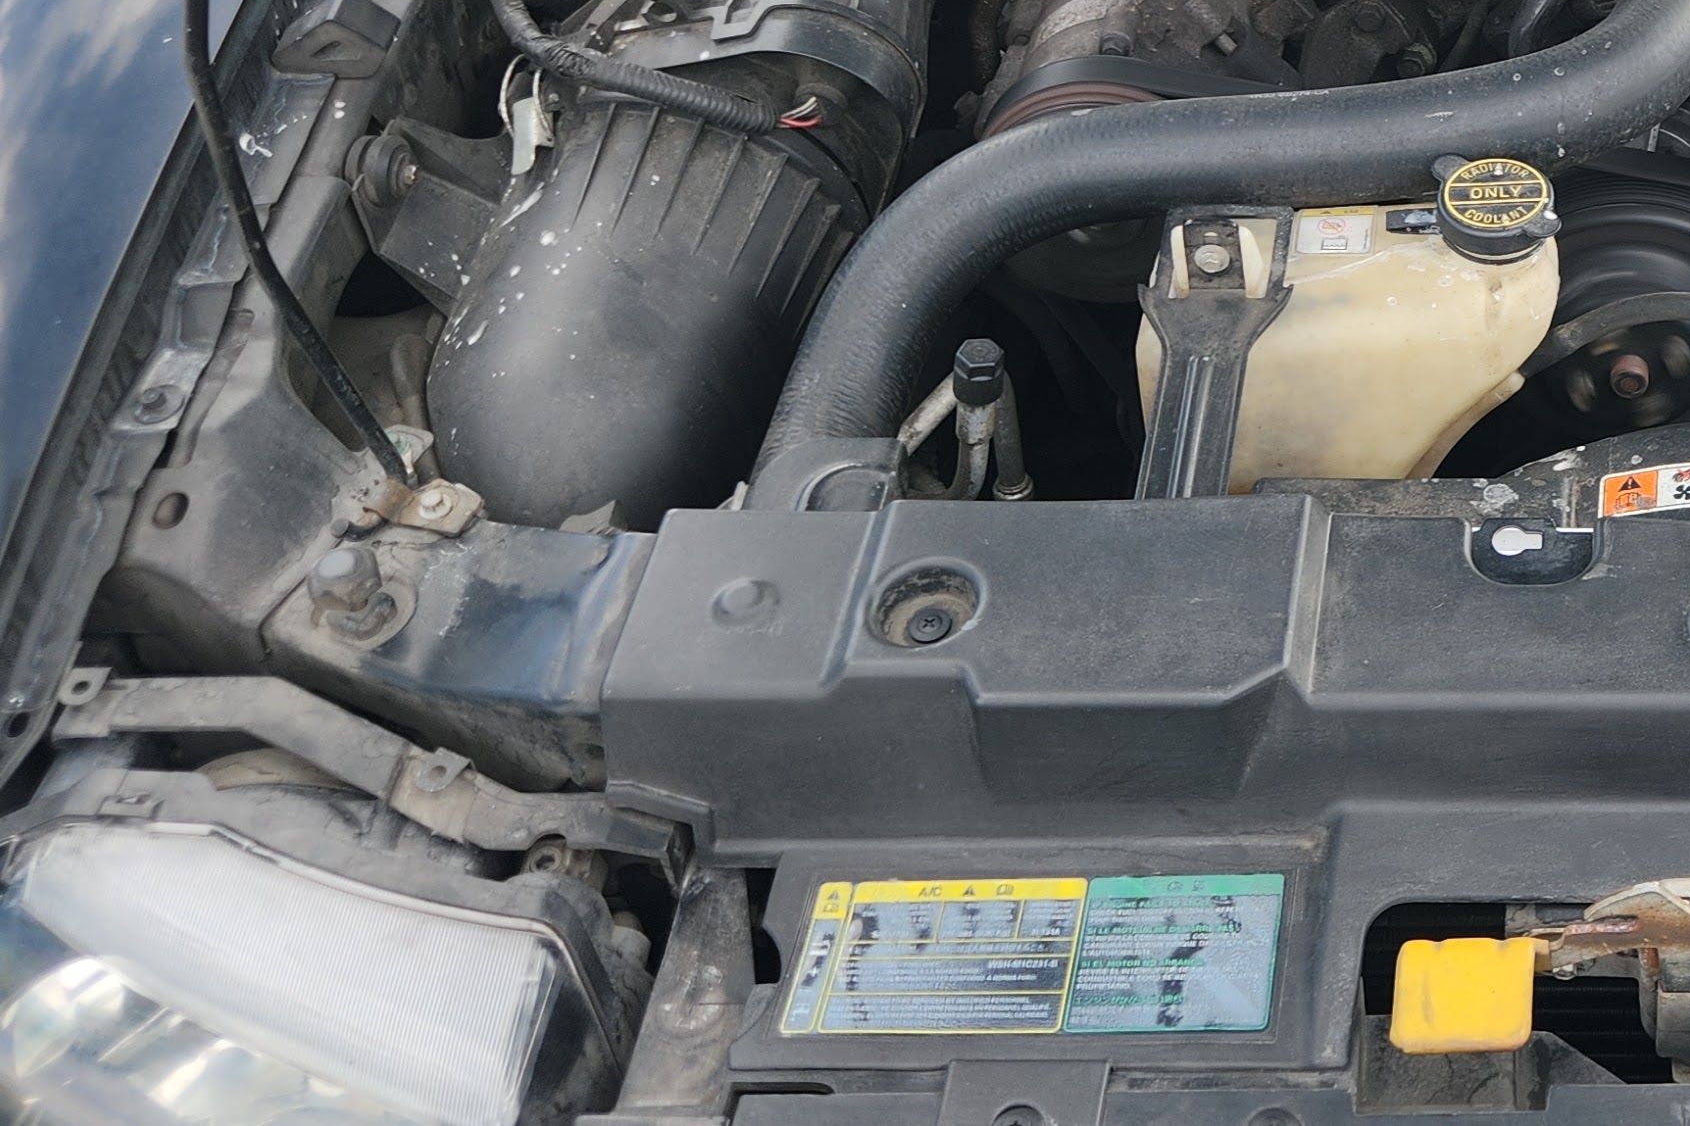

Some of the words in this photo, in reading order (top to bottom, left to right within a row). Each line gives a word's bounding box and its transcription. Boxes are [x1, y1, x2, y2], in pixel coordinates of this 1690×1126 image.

[1460, 162, 1530, 180] RADIATOR
[1470, 185, 1522, 199] ONLY
[1464, 206, 1528, 224] COOLANT
[919, 887, 942, 897] A/C
